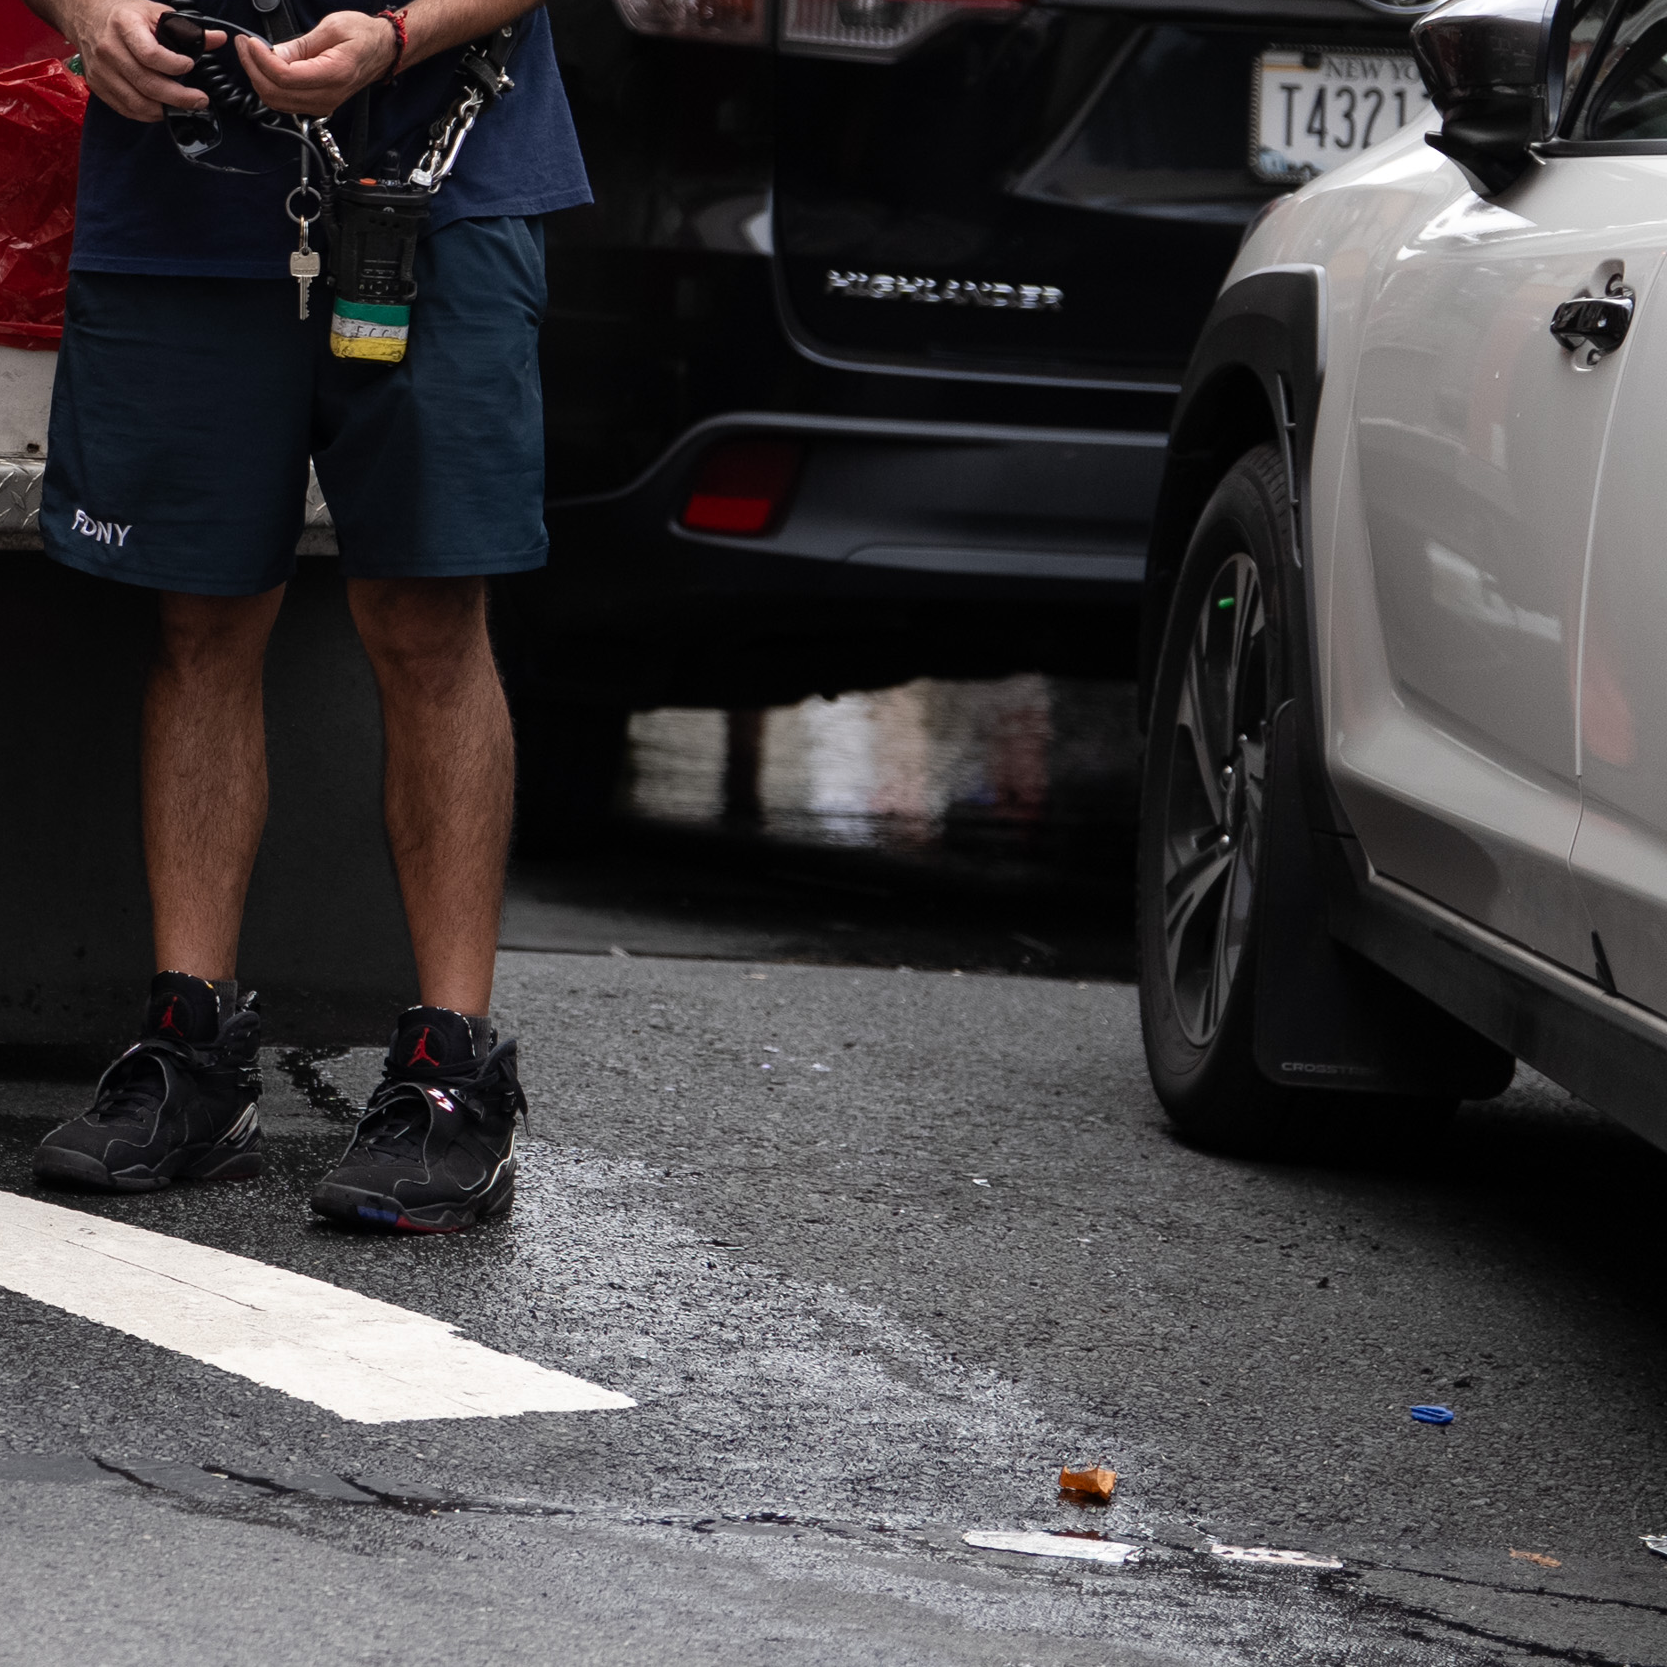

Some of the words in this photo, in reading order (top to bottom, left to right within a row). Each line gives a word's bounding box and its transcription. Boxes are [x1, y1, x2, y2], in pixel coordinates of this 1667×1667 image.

[1325, 56, 1379, 80] NEW
[1391, 58, 1419, 81] YO
[1279, 82, 1430, 150] T4321
[826, 270, 1064, 311] HIGHLANDER
[71, 508, 133, 547] FDNY
